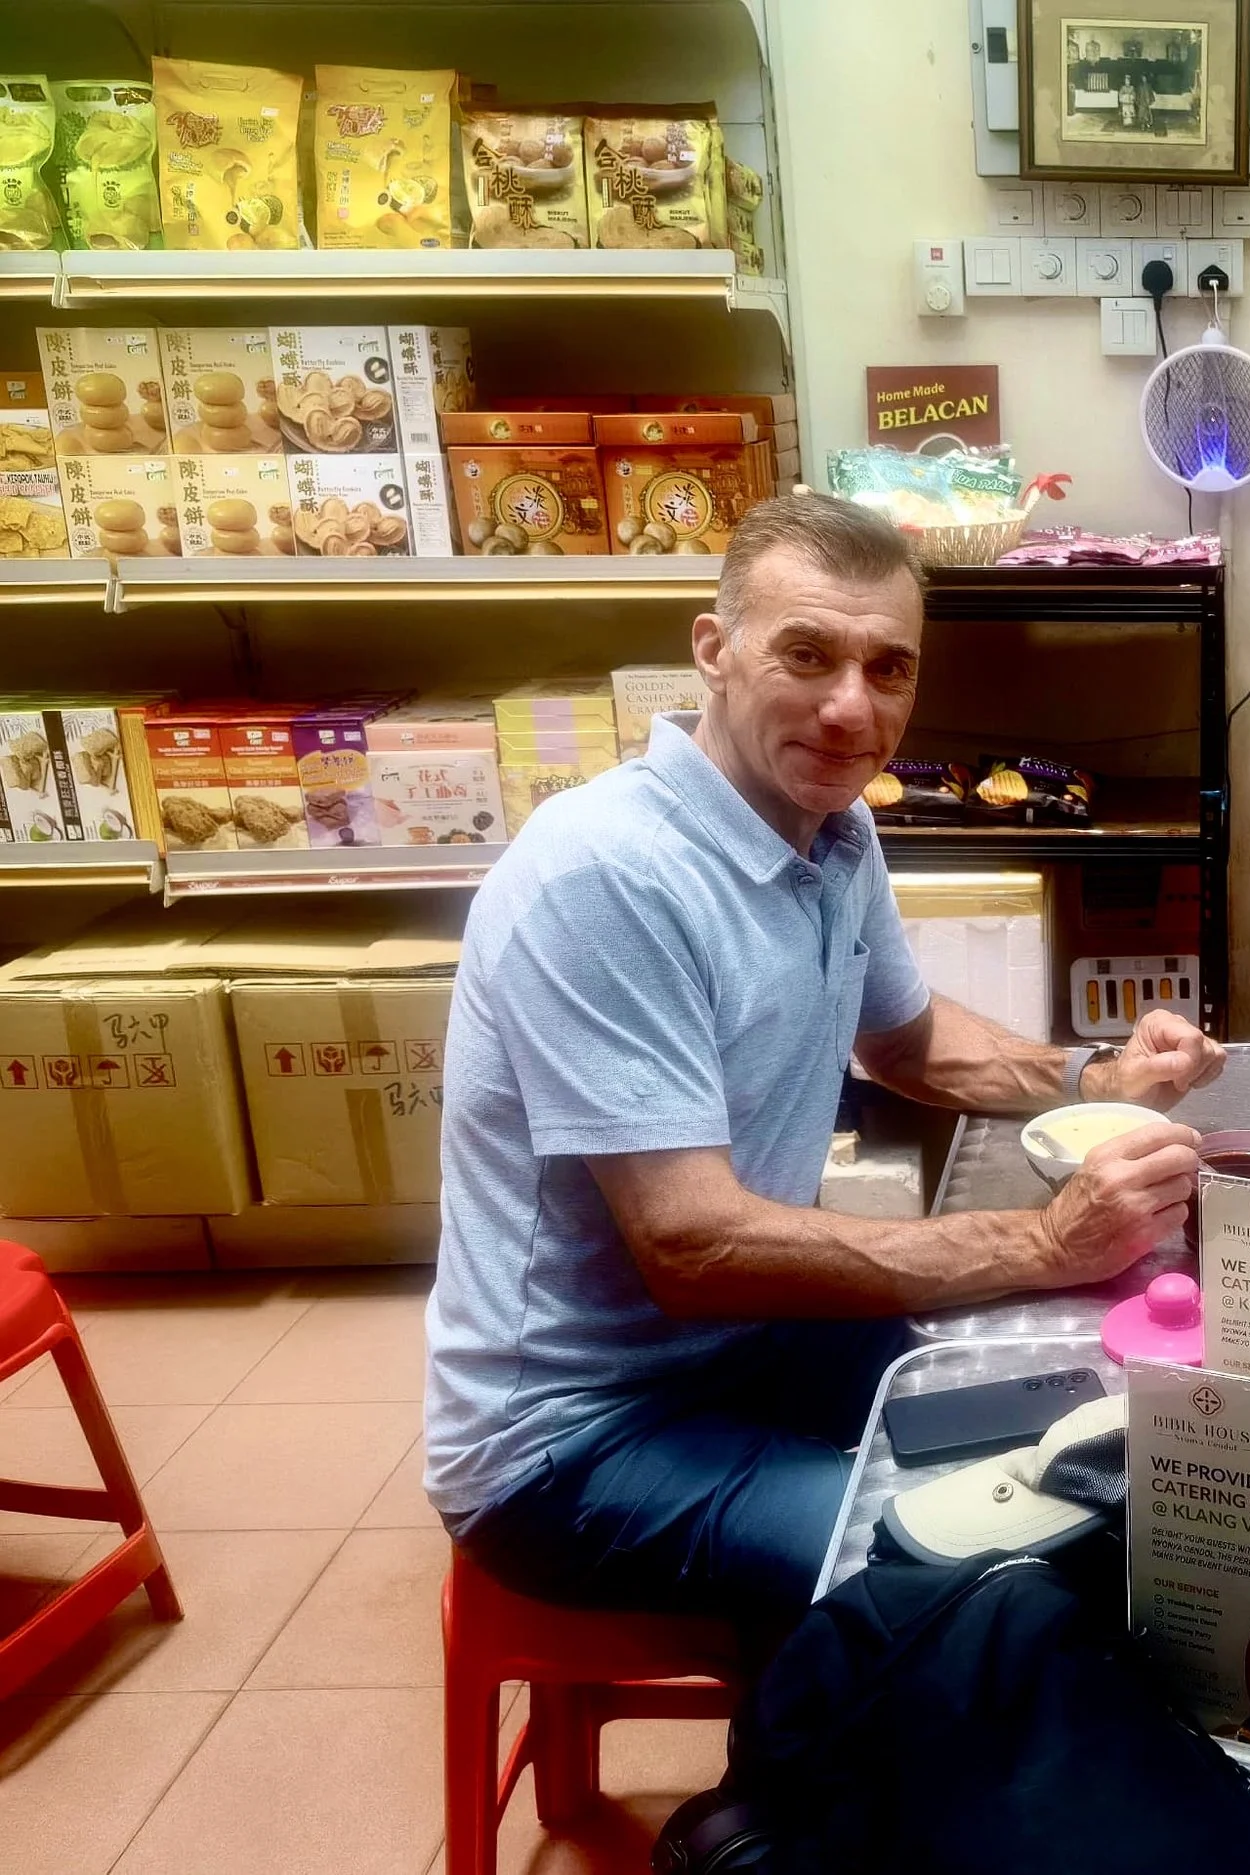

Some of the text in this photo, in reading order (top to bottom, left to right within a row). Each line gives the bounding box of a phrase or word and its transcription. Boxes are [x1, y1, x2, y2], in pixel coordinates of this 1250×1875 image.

[472, 137, 537, 230] 合桃酥
[595, 138, 662, 230] 合桃酥
[877, 382, 946, 404] Home Made
[878, 394, 989, 431] BELACAN
[625, 682, 674, 691] GOLDEN
[626, 692, 703, 703] CASHEW NUT
[104, 1012, 169, 1054] 马六甲
[1221, 1258, 1247, 1274] WE
[1222, 1295, 1235, 1309] @
[1223, 1359, 1241, 1369] OUR
[1153, 1415, 1196, 1434] BIBIK
[1150, 1455, 1182, 1475] WE
[1151, 1478, 1246, 1509] CATERING
[1152, 1500, 1167, 1516] @
[1173, 1503, 1237, 1529] KLANG
[1184, 1533, 1206, 1545] YOUR
[1206, 1538, 1237, 1551] GUESTS
[1175, 1553, 1198, 1566] YOUR
[1198, 1557, 1223, 1570] EVENT
[1154, 1578, 1219, 1598] OUR SERVICE
